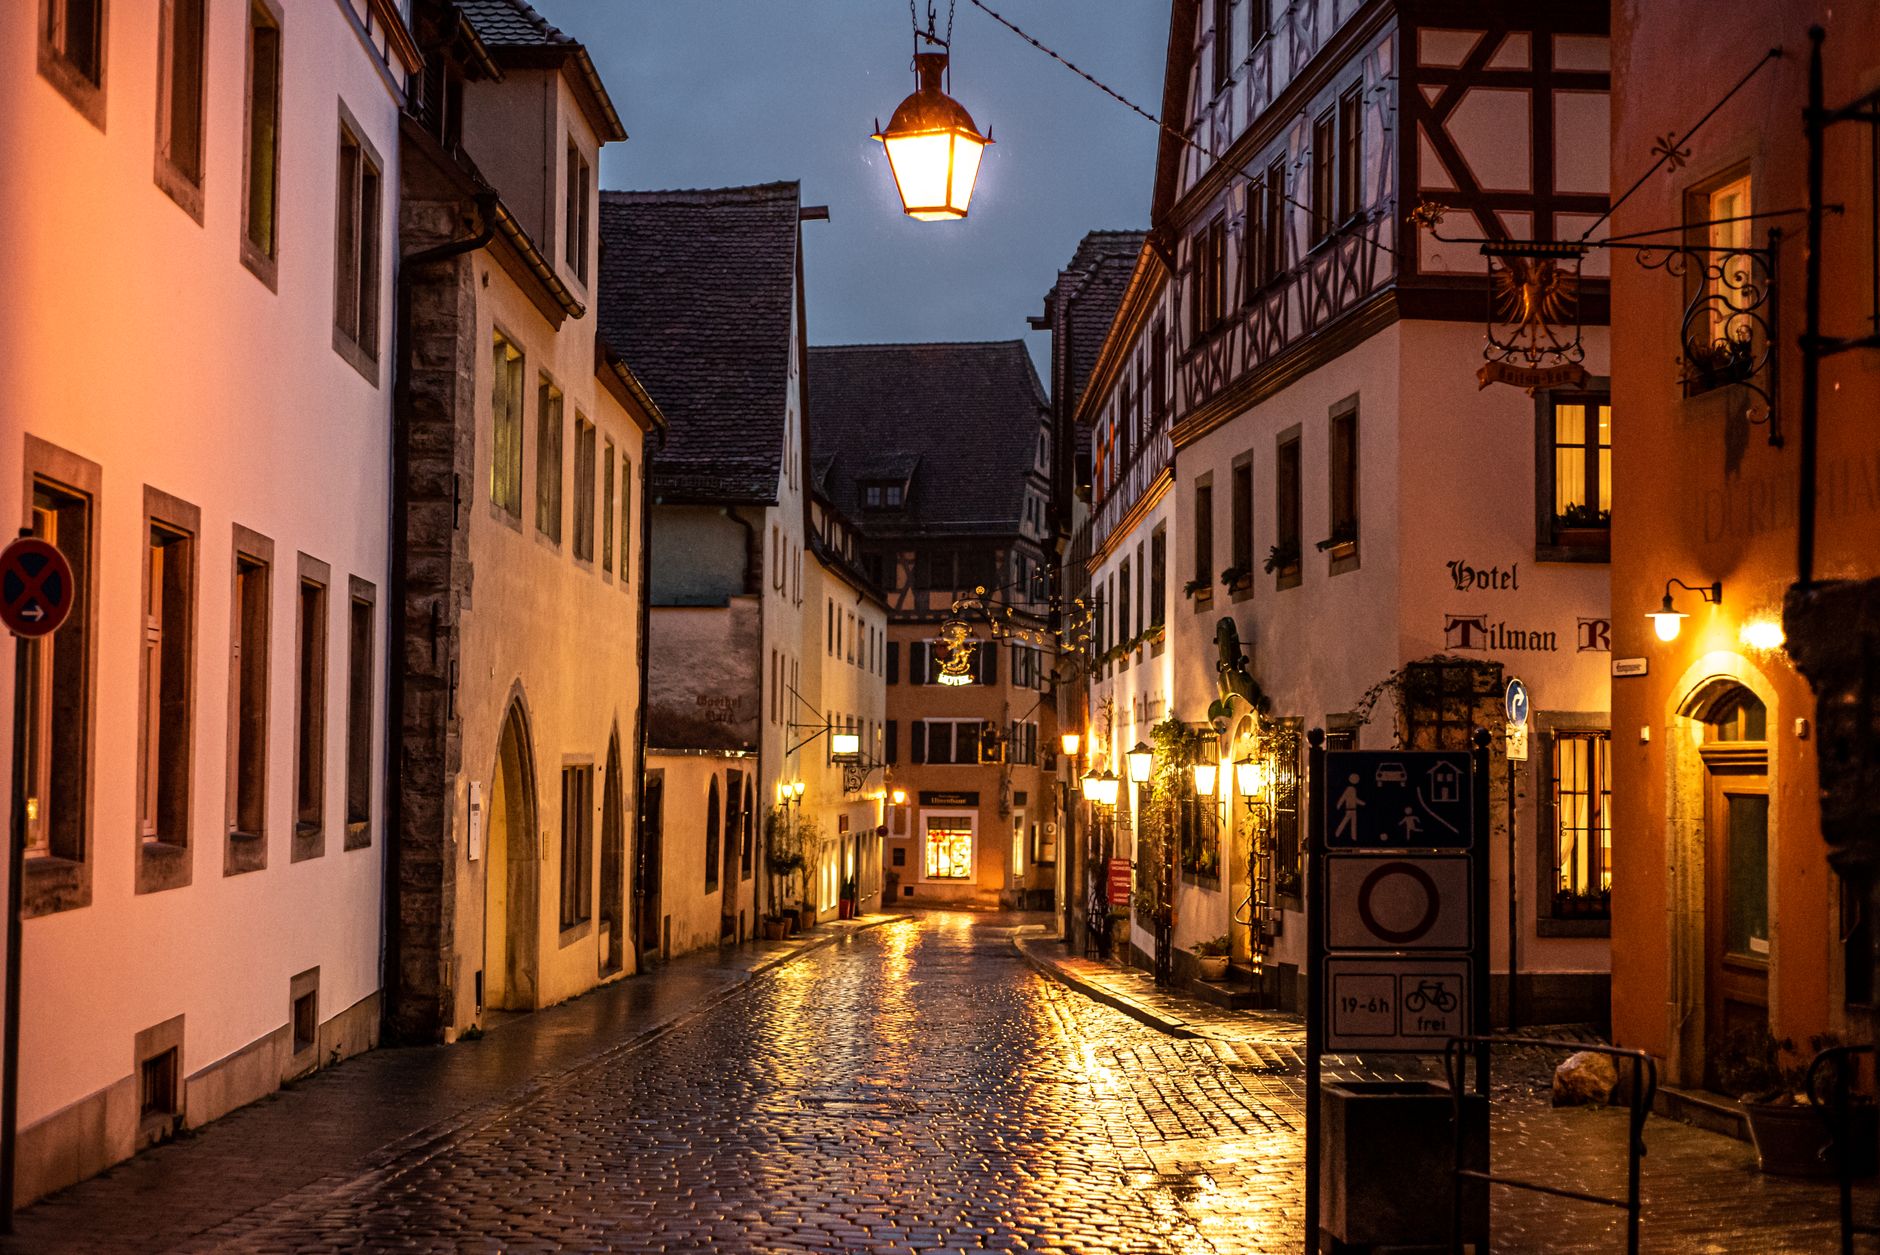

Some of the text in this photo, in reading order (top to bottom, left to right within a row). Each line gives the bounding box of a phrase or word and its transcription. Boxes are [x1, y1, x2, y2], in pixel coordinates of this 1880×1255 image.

[1446, 559, 1519, 592] Hotel
[1444, 614, 1558, 652] Tilman
[1417, 1016, 1446, 1031] frei
